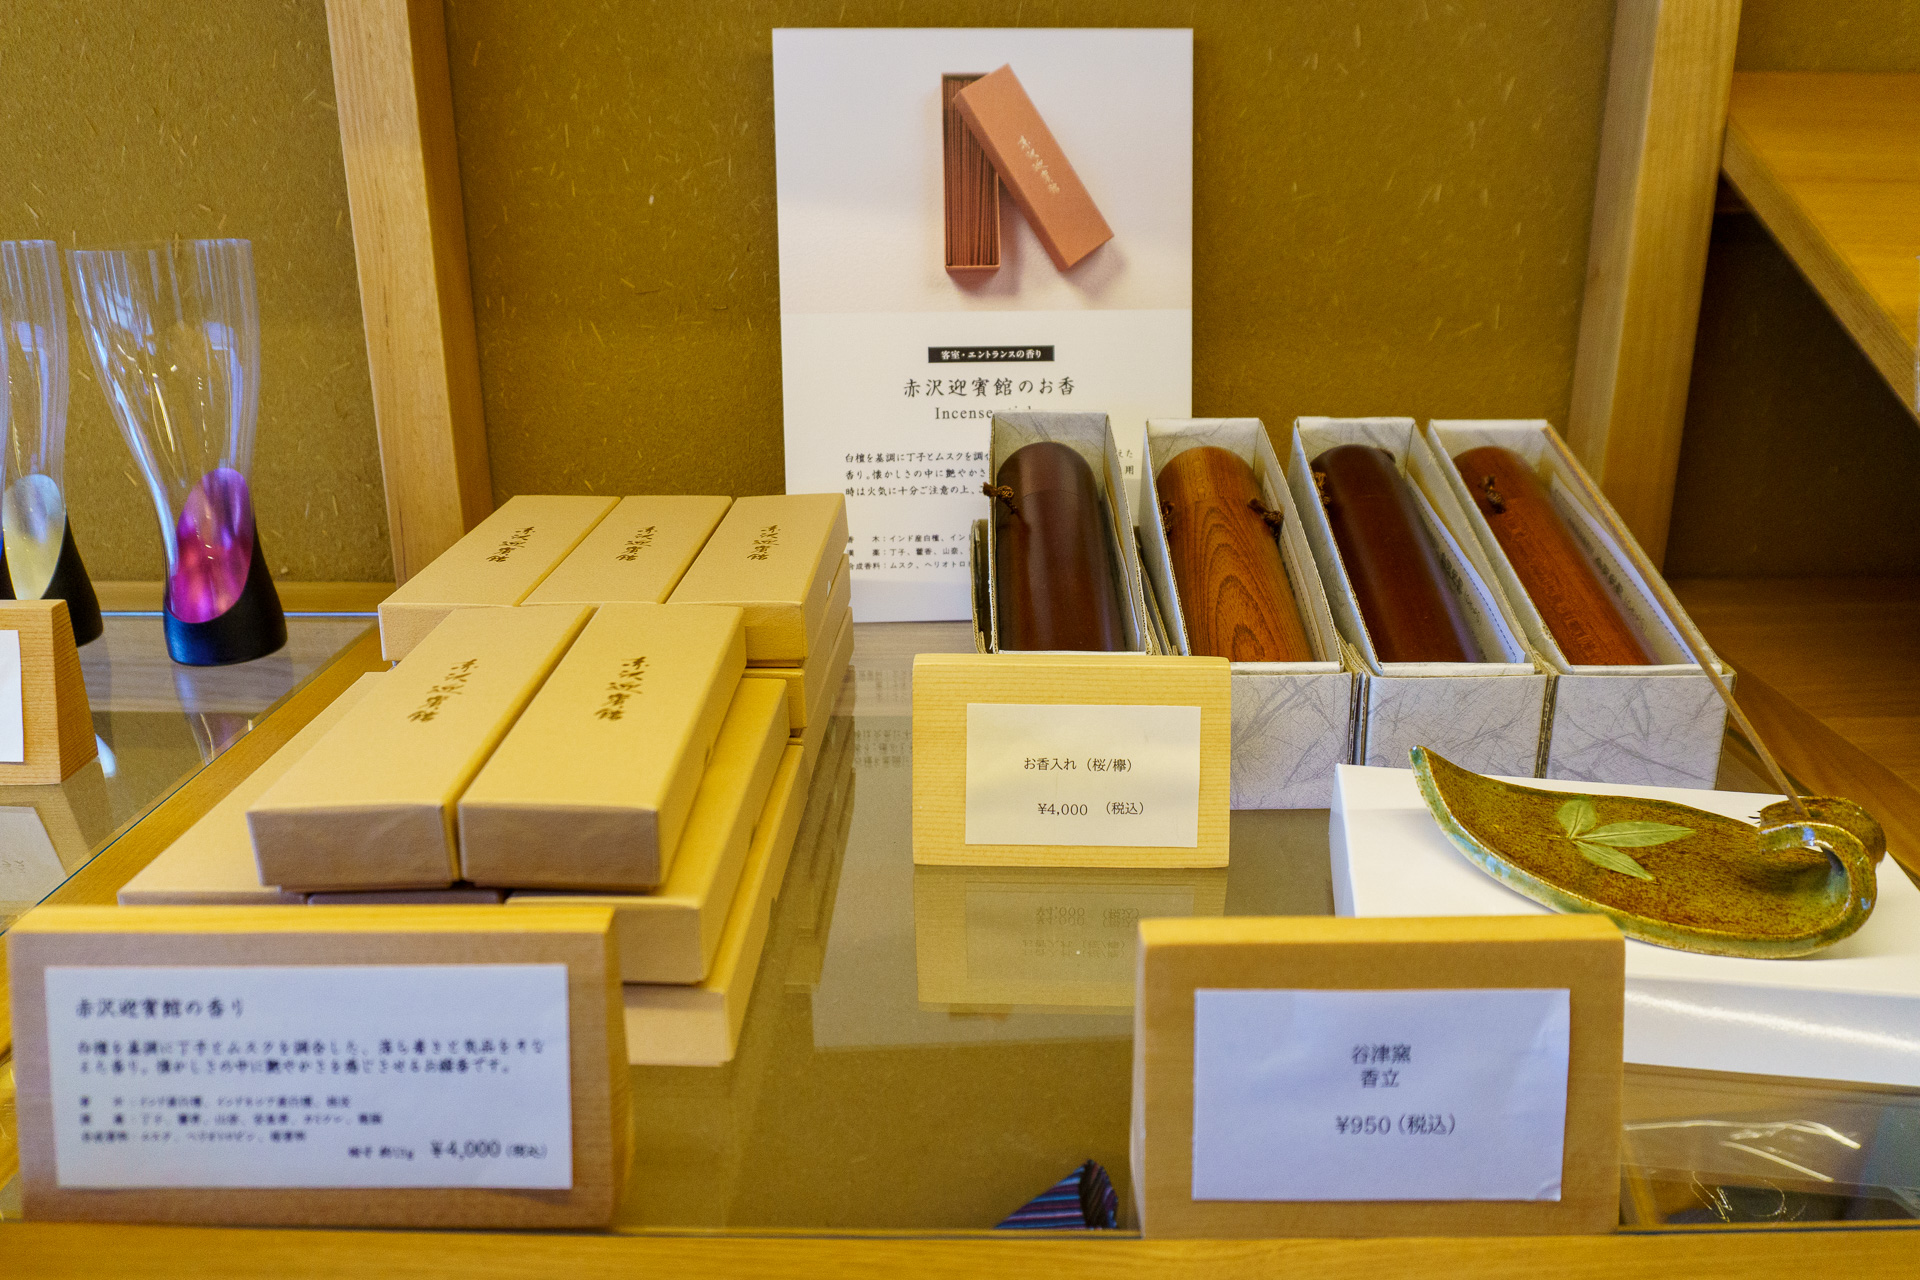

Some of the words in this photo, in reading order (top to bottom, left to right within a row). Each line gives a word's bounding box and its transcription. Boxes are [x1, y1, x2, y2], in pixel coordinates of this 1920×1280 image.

[941, 349, 1042, 360] 客室・エントランスの香り
[903, 377, 1075, 398] 赤沢迎賓館のお香
[935, 407, 994, 420] Incense
[1037, 803, 1089, 816] ¥4,000
[1105, 801, 1145, 816] （税込）
[1361, 1067, 1400, 1089] 香立
[1336, 1115, 1391, 1135] ¥950
[430, 1139, 500, 1161] ¥4,000
